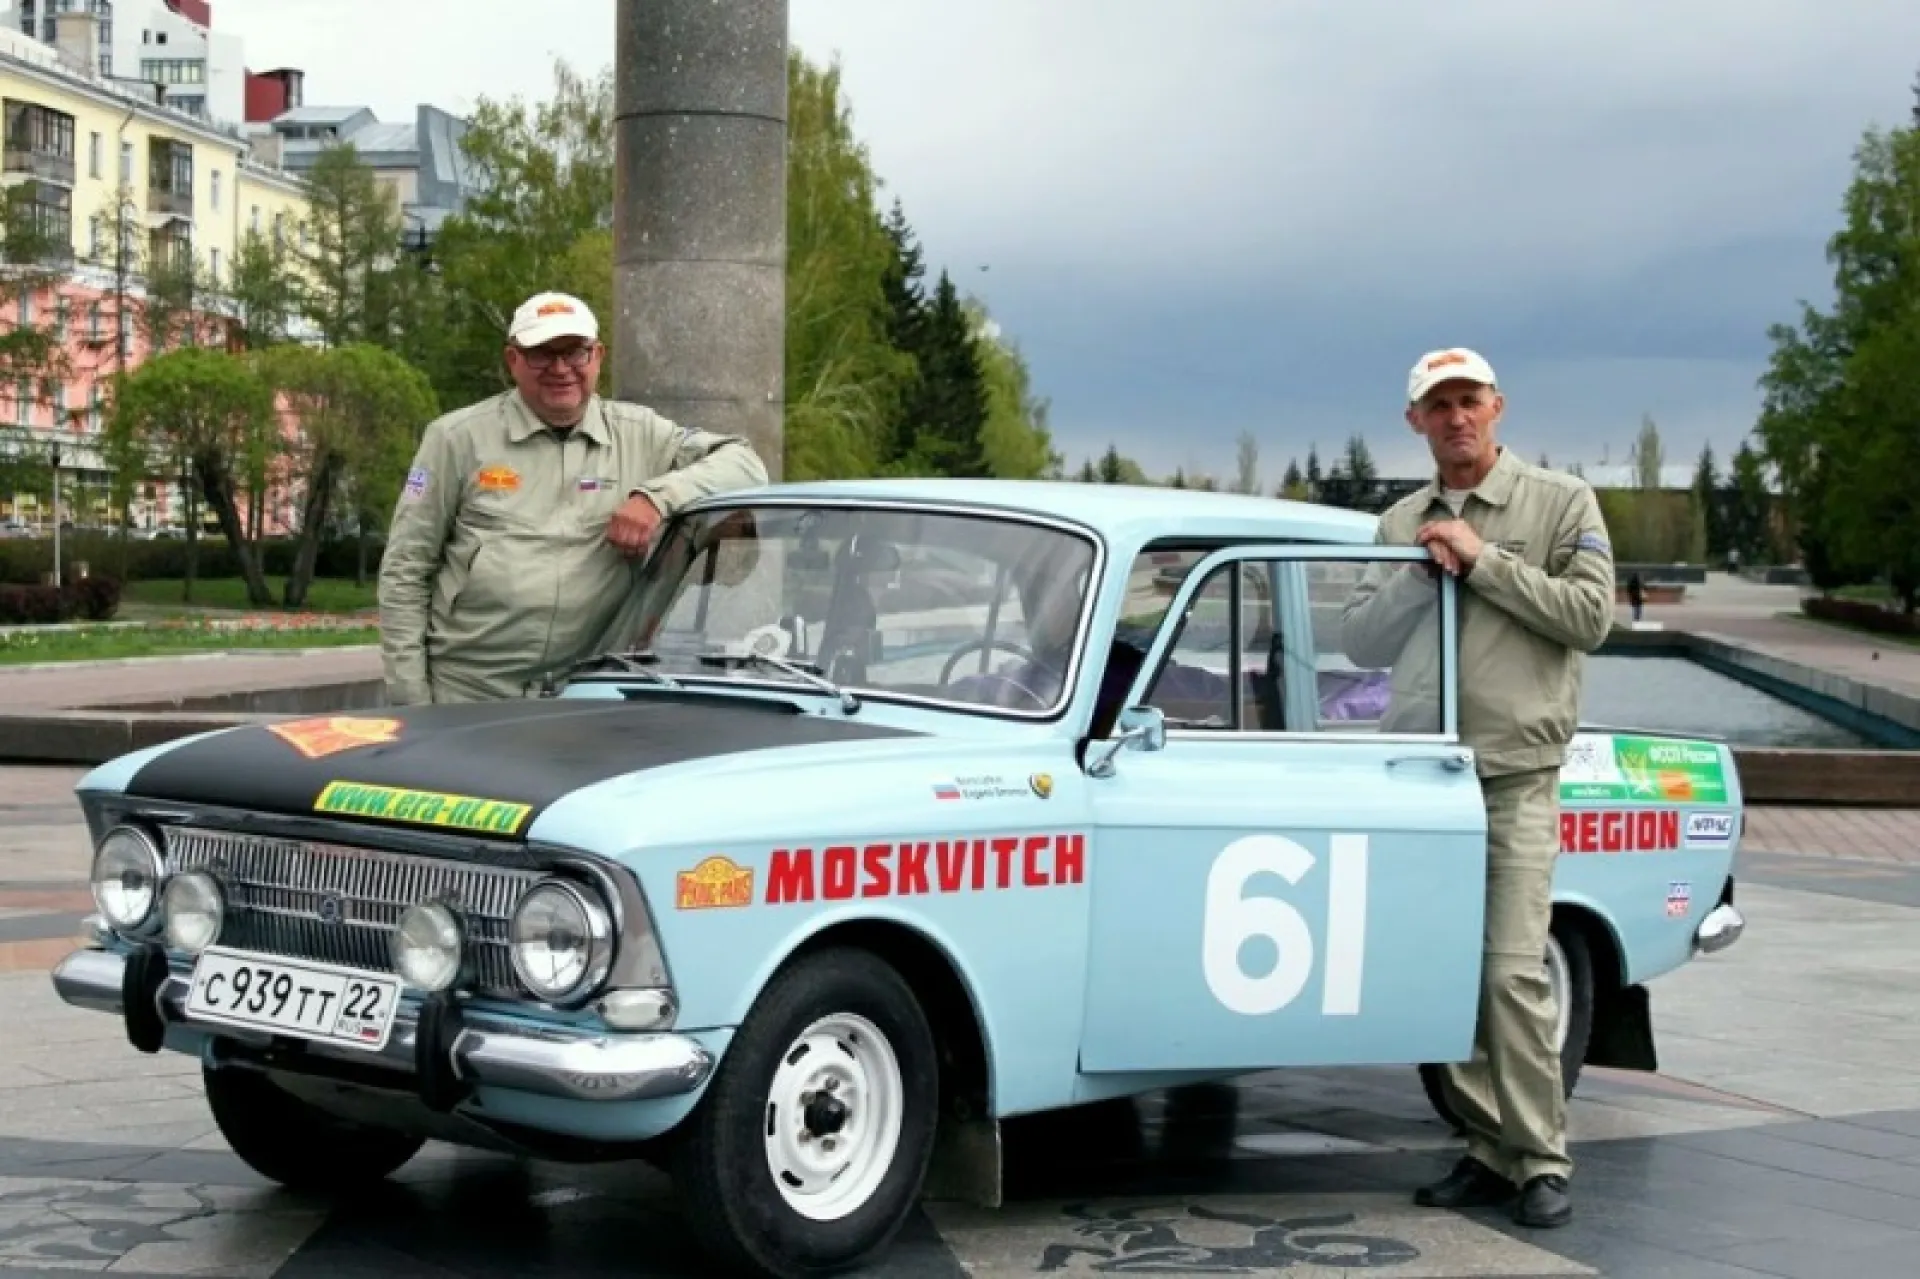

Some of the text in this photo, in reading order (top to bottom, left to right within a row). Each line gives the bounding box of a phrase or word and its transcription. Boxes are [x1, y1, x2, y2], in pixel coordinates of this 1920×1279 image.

[1559, 811, 1680, 853] REGION
[765, 834, 1084, 905] MOSKVITCH
[1203, 834, 1368, 1015] 61
[343, 983, 381, 1020] 22
